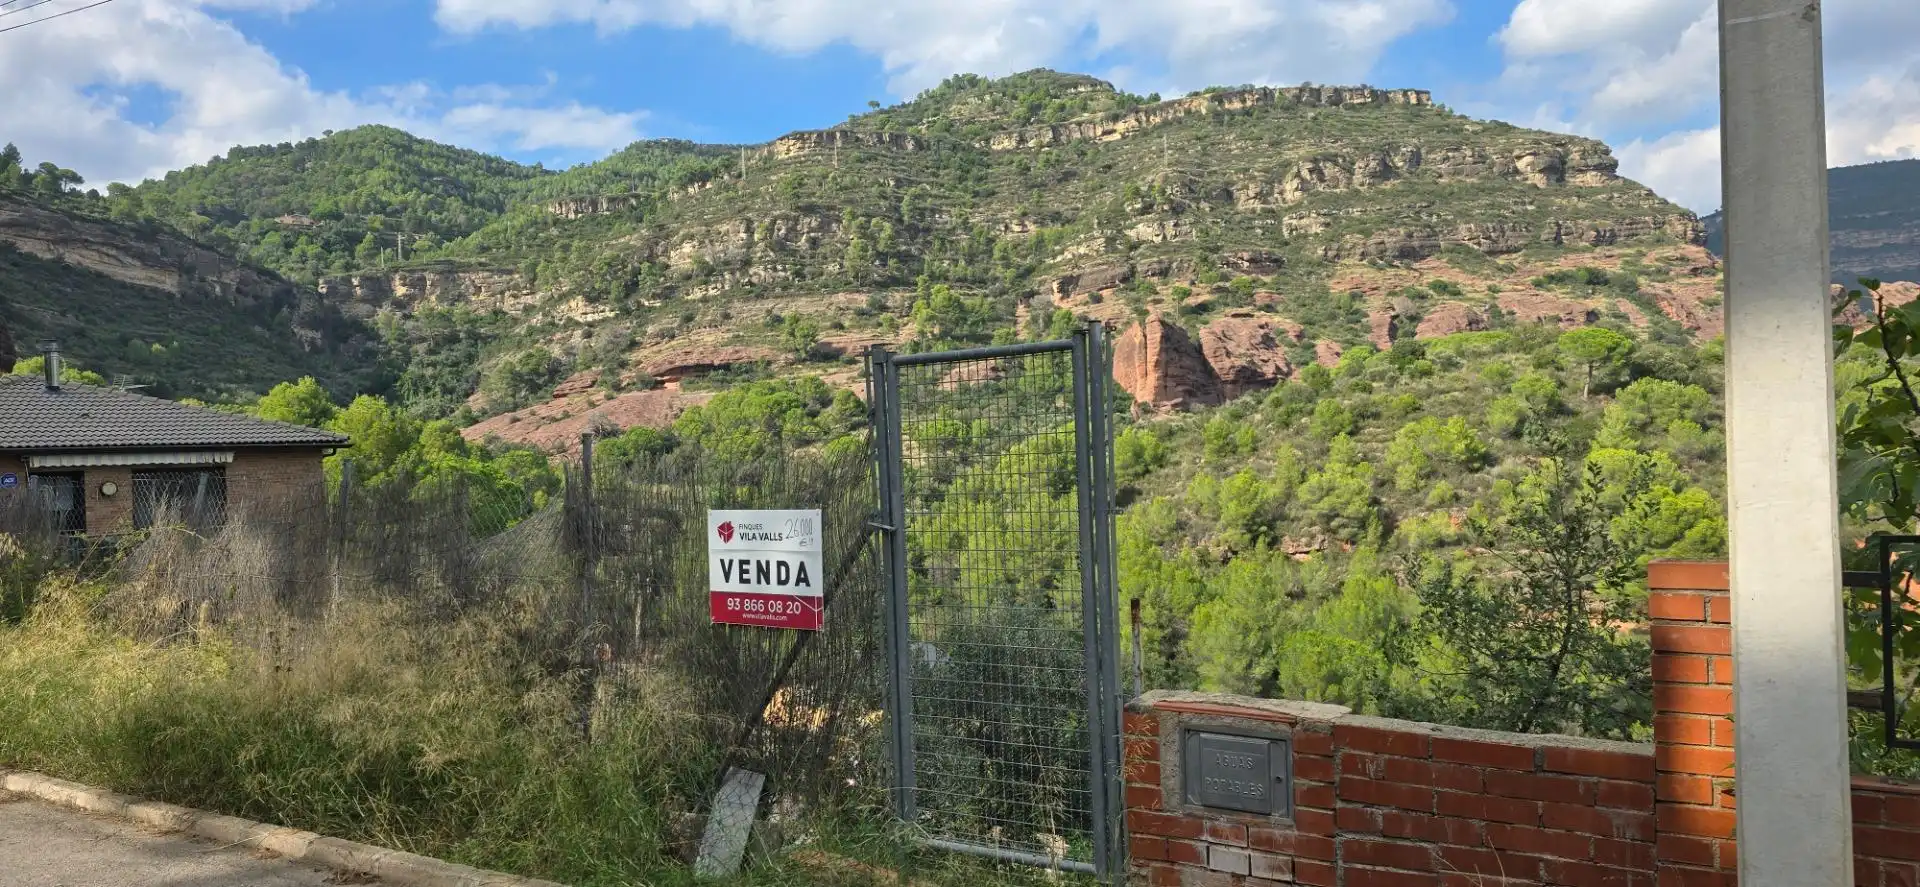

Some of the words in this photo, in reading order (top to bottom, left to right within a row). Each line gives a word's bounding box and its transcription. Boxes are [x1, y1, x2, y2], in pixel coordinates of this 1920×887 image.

[739, 532, 757, 541] VILA
[759, 533, 783, 542] VALLS
[720, 559, 810, 587] VENDA
[727, 598, 740, 610] 93
[743, 599, 764, 612] 866
[768, 600, 783, 613] 08
[786, 601, 801, 614] 20
